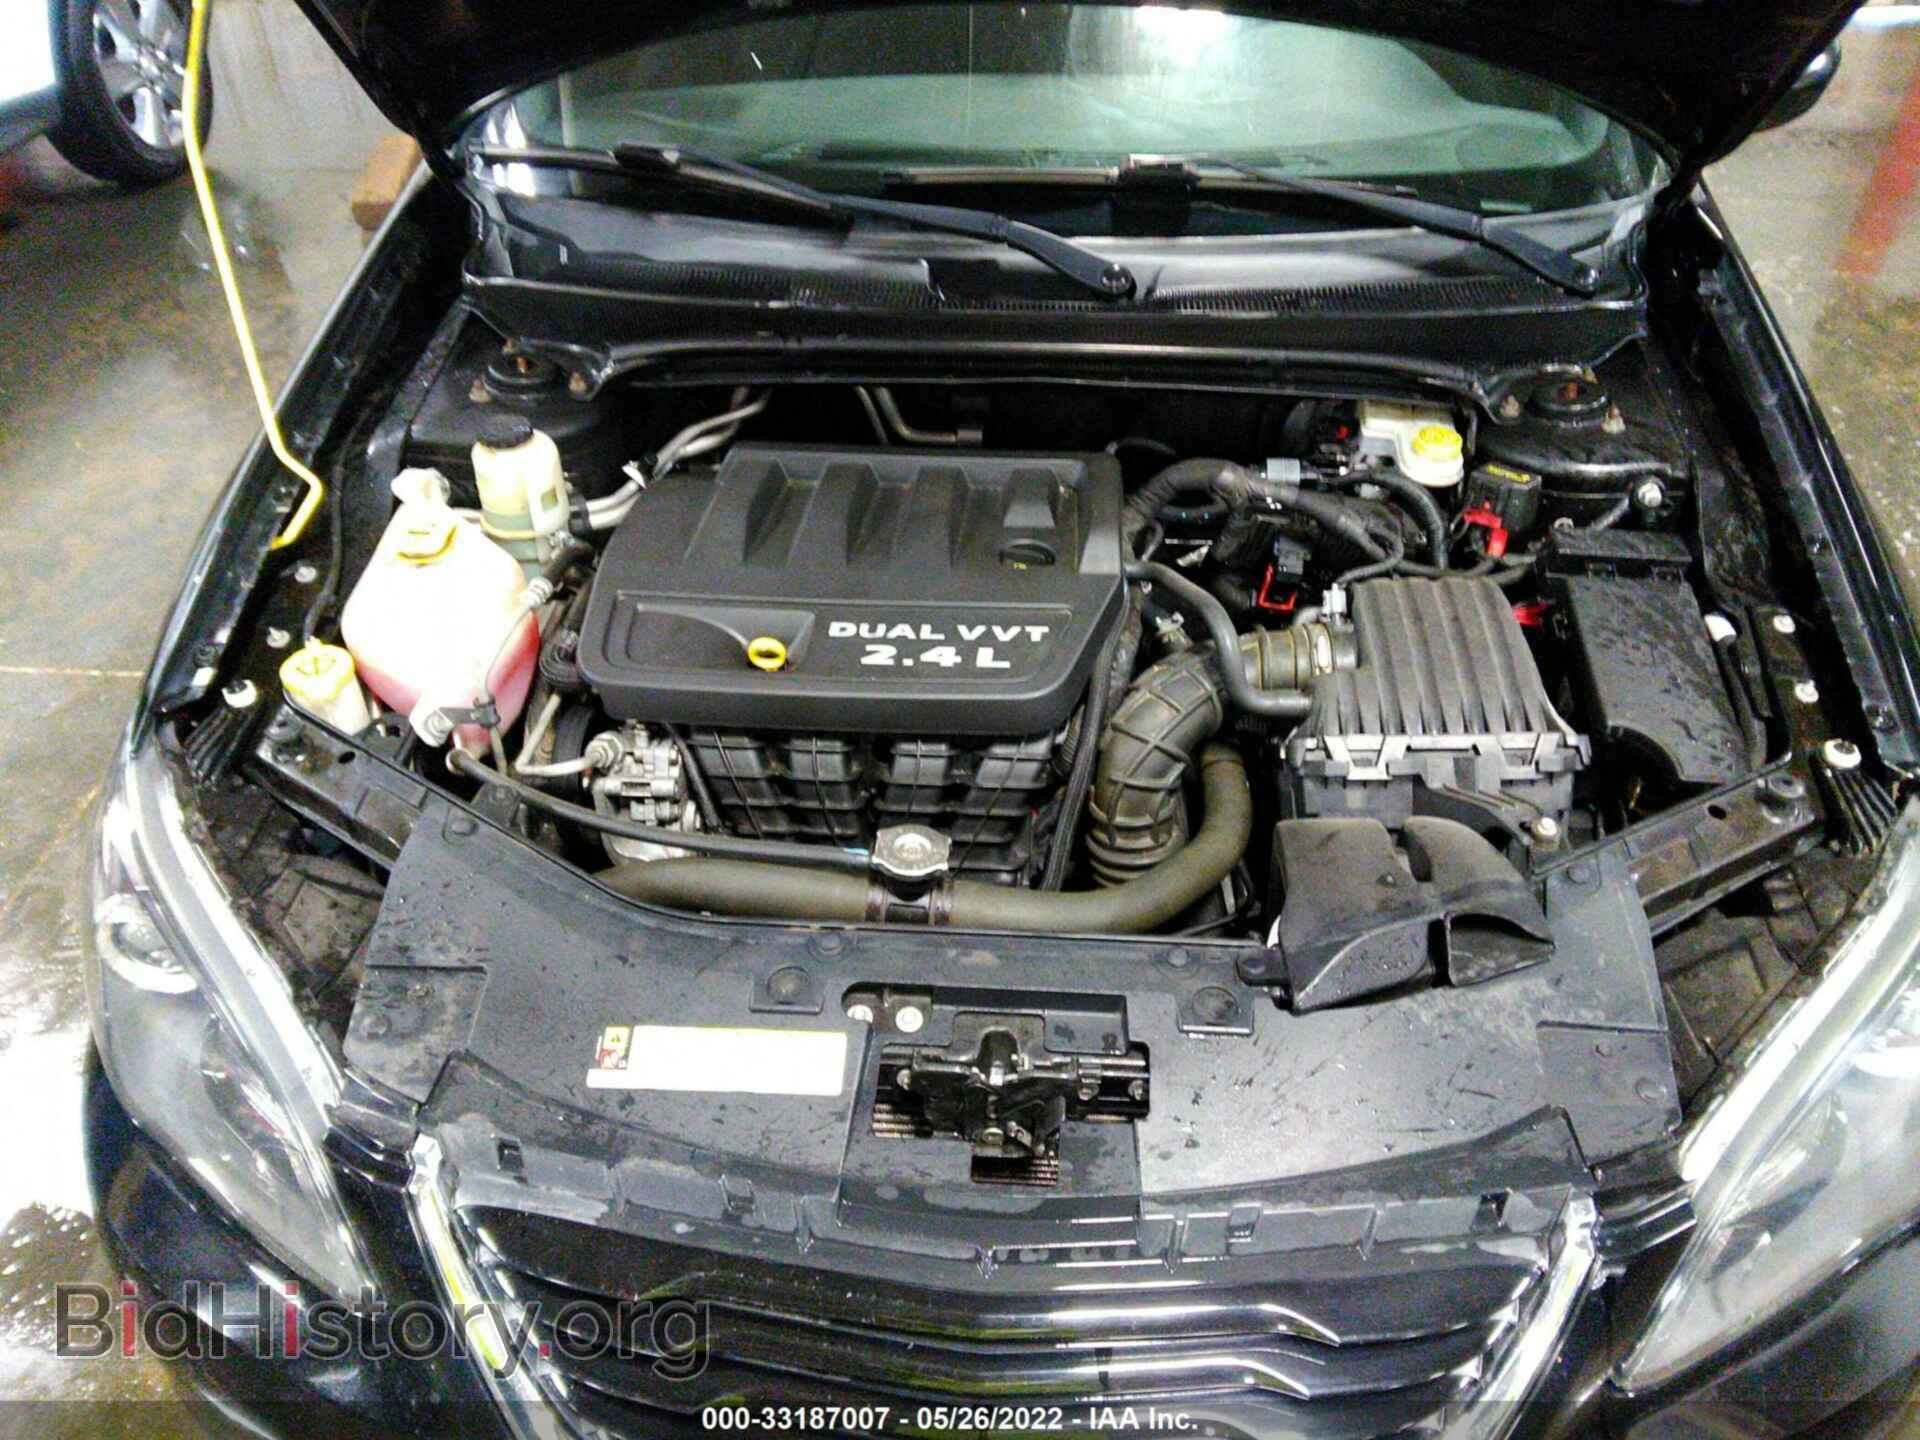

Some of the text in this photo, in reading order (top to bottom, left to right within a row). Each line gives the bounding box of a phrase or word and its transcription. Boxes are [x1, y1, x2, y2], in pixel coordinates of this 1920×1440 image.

[828, 620, 1051, 643] DUAL VVT
[860, 643, 1012, 669] 2.4 L
